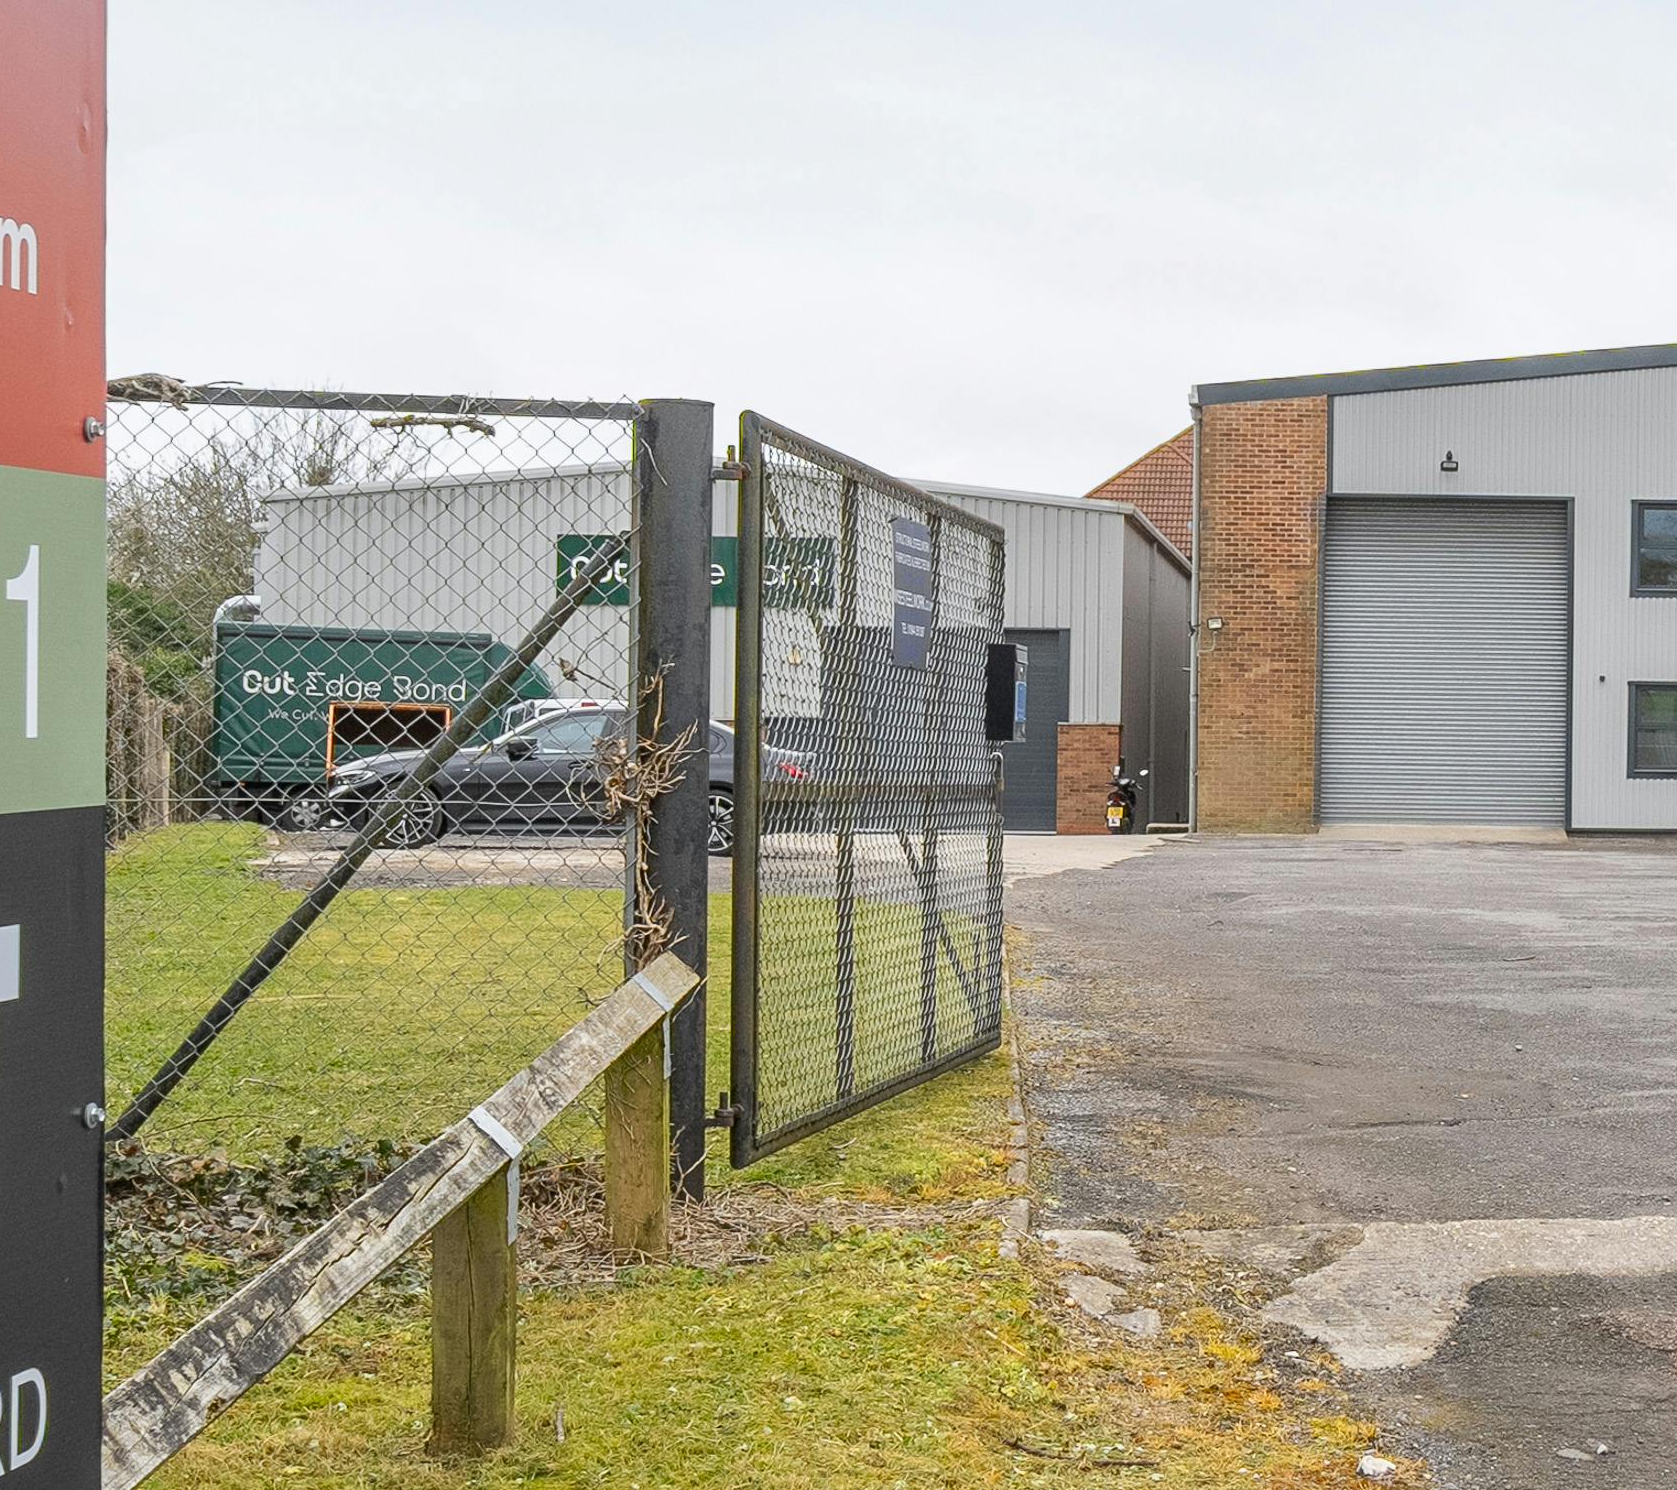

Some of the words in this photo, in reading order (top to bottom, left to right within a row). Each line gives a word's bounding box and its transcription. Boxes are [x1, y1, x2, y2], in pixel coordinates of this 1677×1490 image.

[242, 669, 296, 695] Cut
[305, 671, 382, 702] Edge
[393, 675, 467, 702] Bond
